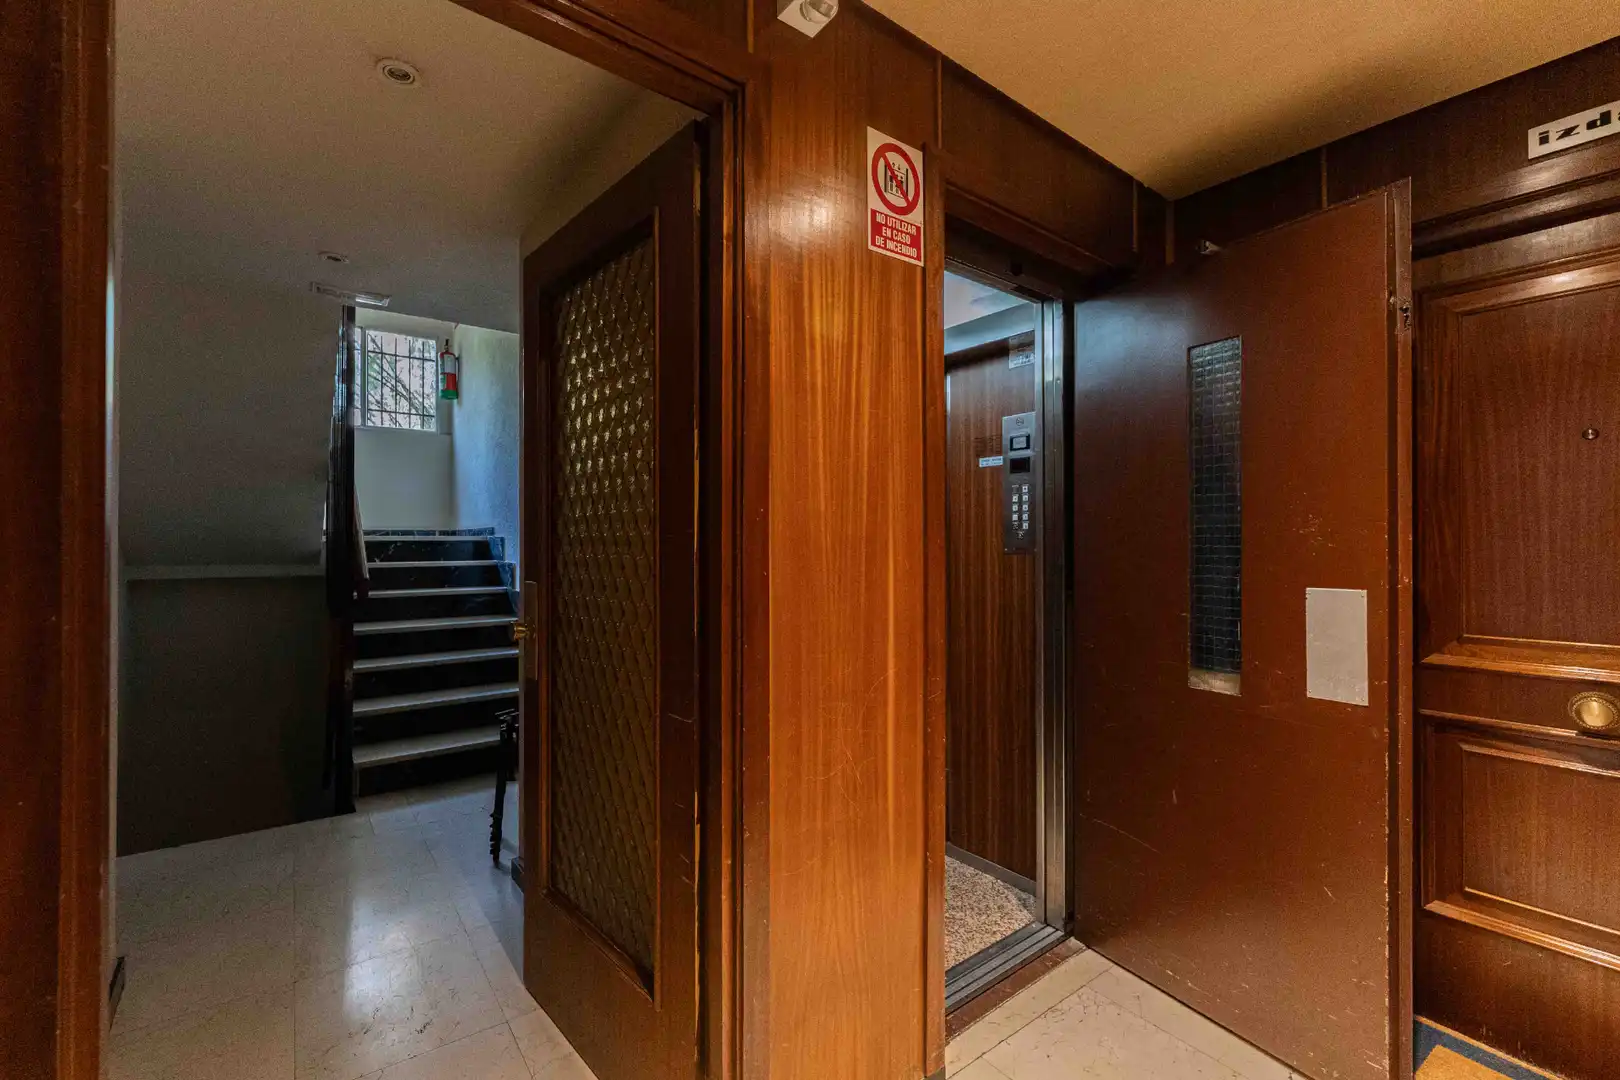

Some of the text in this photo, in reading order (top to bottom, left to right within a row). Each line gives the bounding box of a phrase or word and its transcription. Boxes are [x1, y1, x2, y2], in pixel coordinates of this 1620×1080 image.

[1538, 109, 1620, 147] izd
[876, 212, 917, 236] NO UTILIZAR
[882, 226, 911, 244] EN CASO
[875, 235, 918, 258] DE INCENDIO
